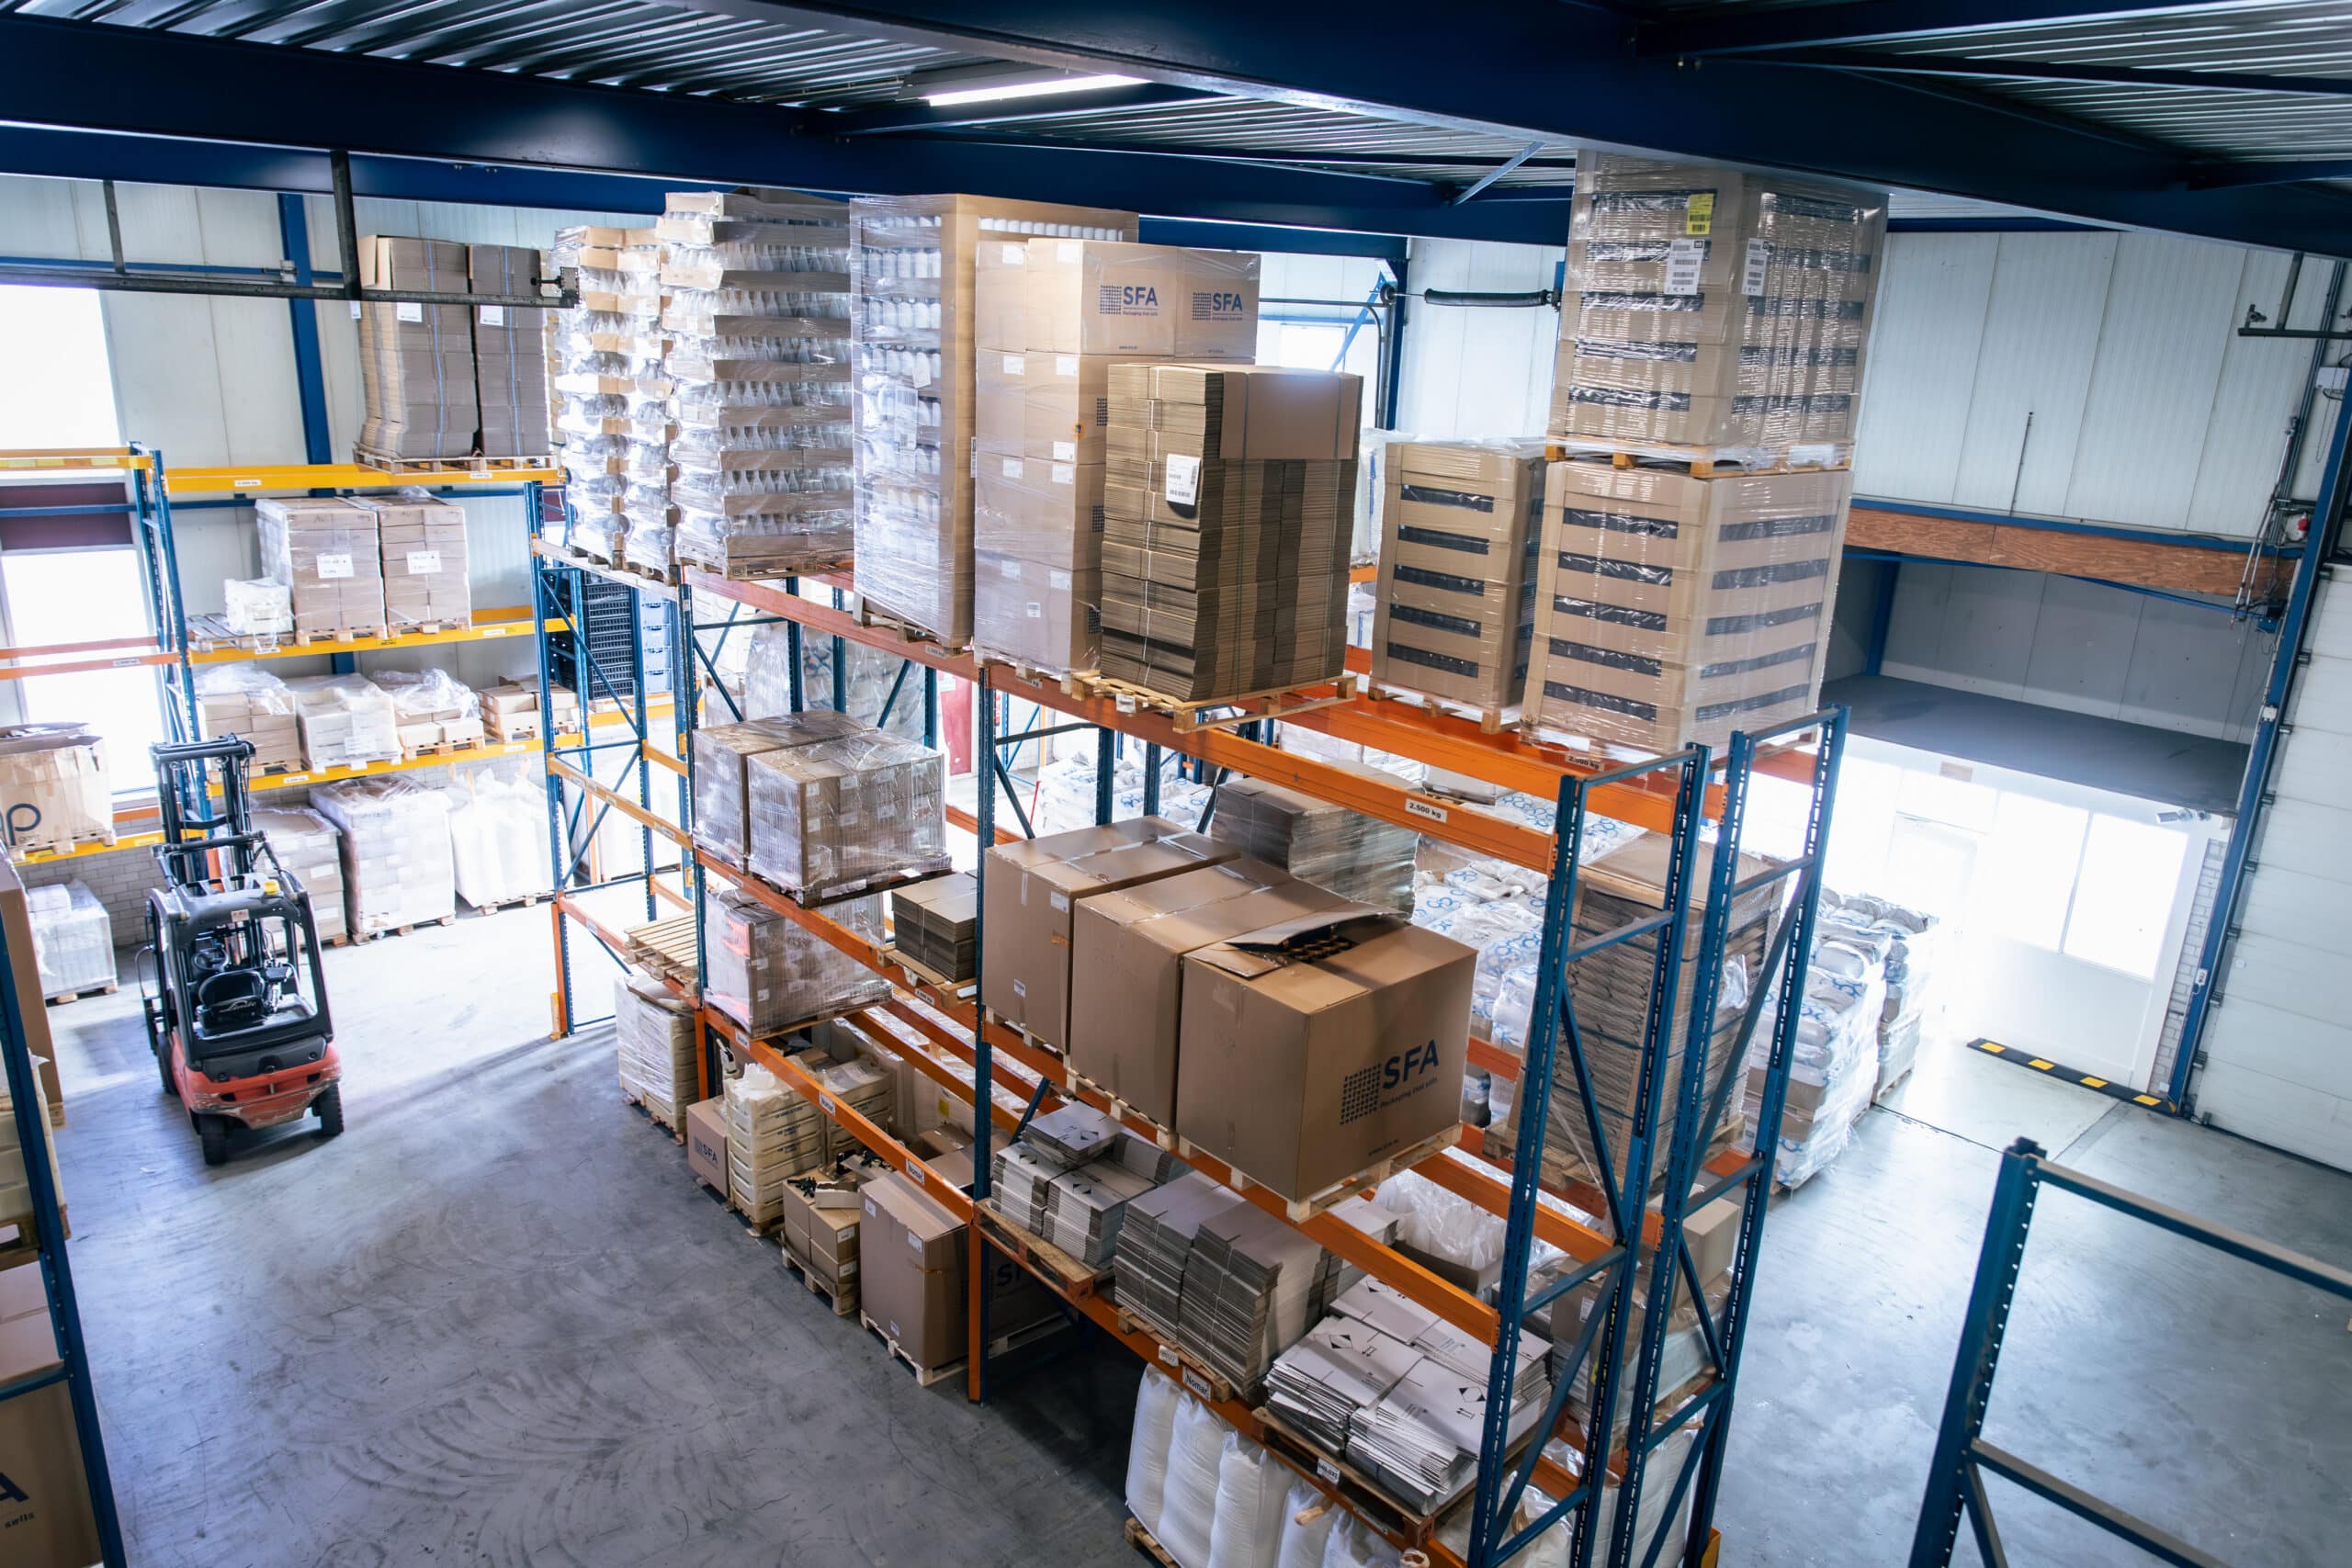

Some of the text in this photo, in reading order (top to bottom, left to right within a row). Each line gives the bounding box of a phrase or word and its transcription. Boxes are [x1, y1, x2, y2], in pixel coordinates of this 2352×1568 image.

[1123, 286, 1159, 306] SFA
[1212, 292, 1243, 311] SFA
[1408, 802, 1442, 819] 2.500 kg
[1382, 1039, 1439, 1089] SFA
[703, 1144, 718, 1165] SFA
[908, 1162, 922, 1180] Nomar
[1185, 1372, 1209, 1395] Nomar
